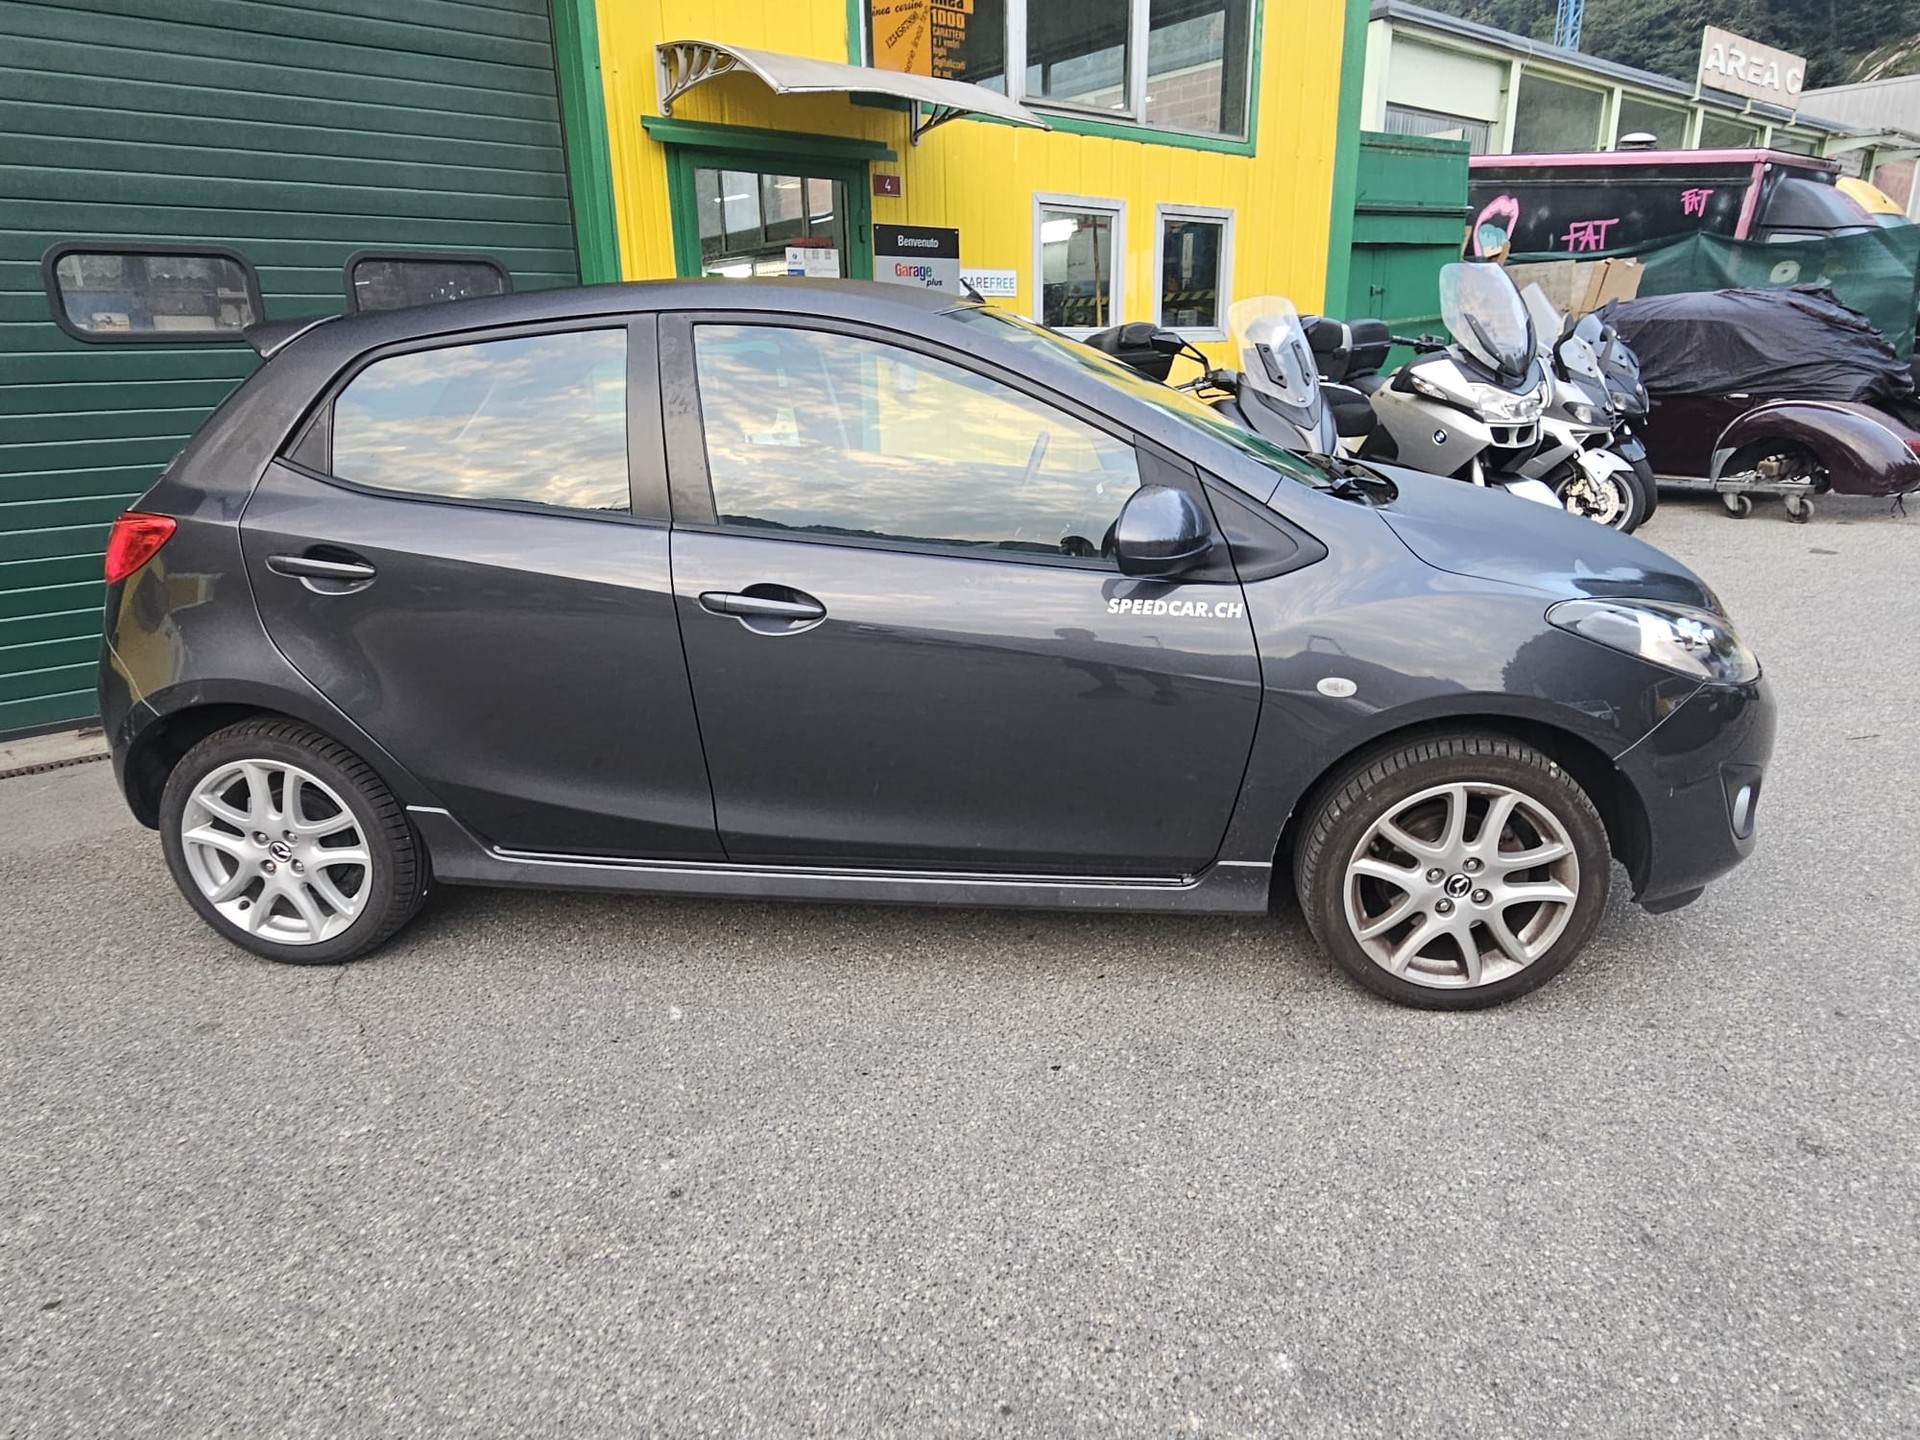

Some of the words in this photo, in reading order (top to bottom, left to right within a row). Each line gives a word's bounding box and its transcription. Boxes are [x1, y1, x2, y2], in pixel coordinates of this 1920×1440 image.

[931, 8, 965, 28] 1000
[1704, 43, 1780, 90] AREA
[1785, 67, 1801, 95] C
[884, 178, 892, 192] 4
[897, 235, 939, 248] Benvenuto
[1560, 218, 1620, 252] FAT
[894, 263, 933, 281] Garage
[926, 278, 943, 288] plus
[1107, 598, 1243, 618] SPEEDCAR.CH
